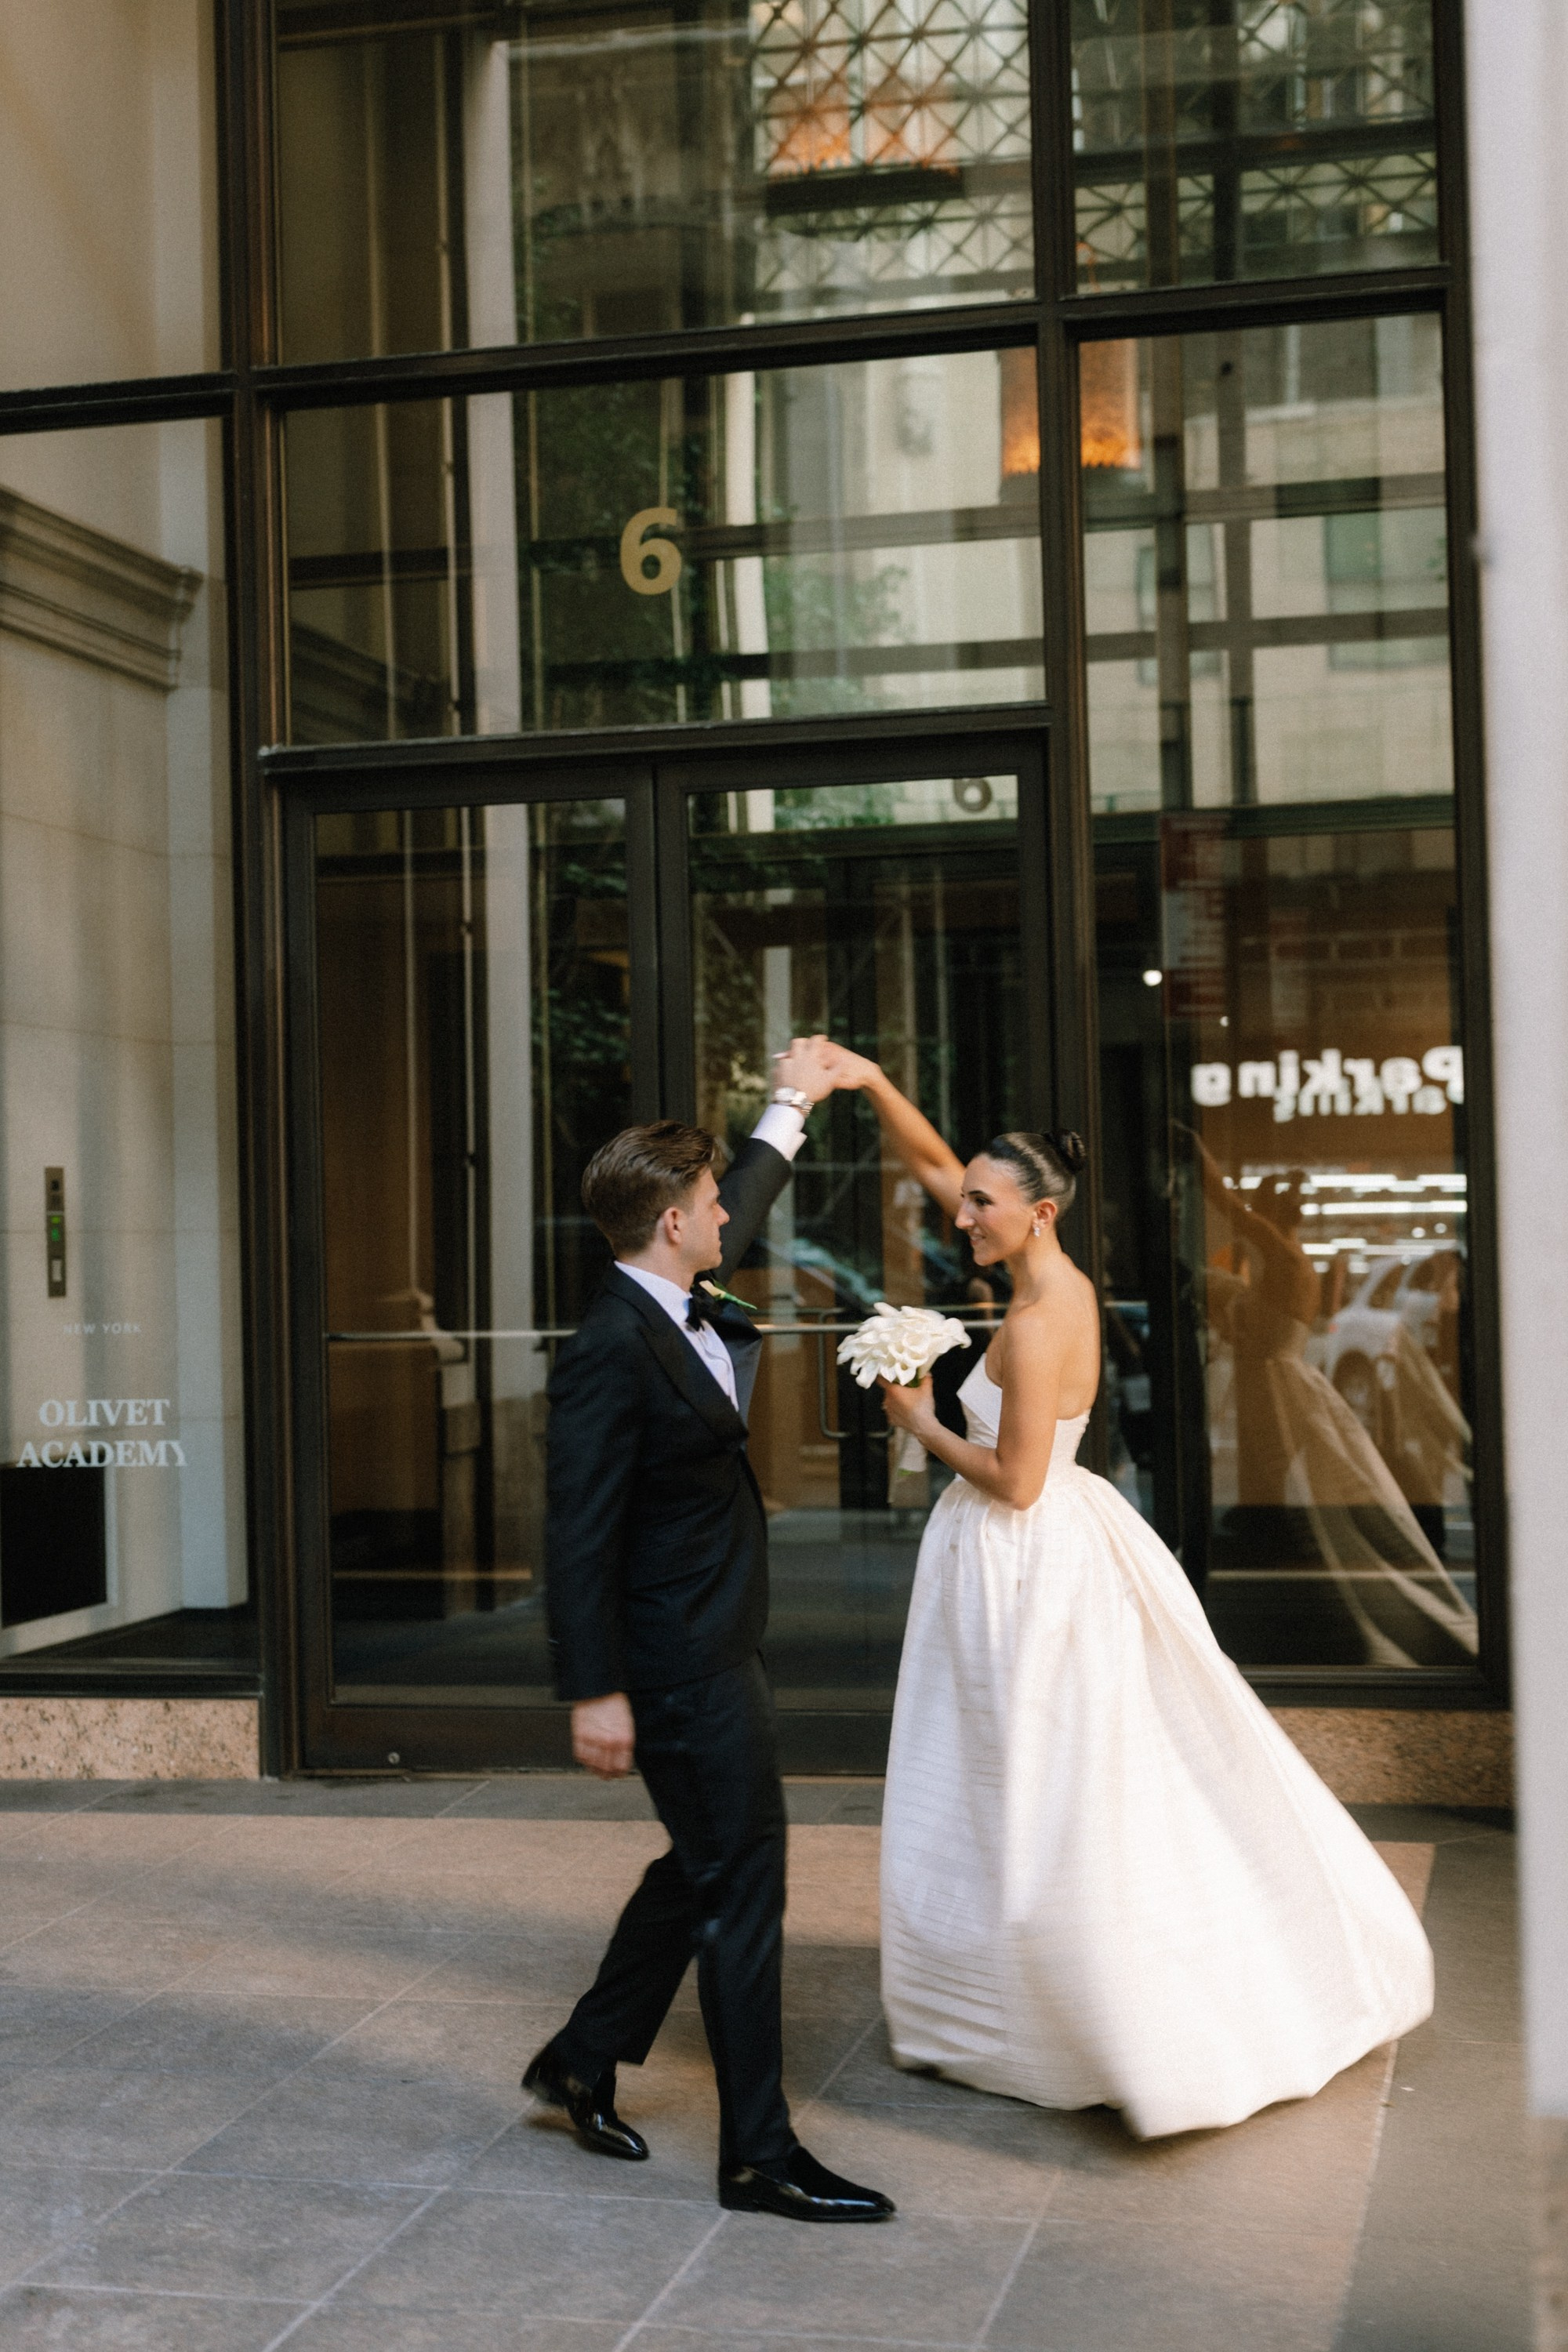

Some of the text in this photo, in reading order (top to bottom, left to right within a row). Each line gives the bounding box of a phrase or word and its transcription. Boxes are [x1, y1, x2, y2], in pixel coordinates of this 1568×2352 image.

[620, 507, 681, 594] 6
[63, 1323, 141, 1334] NEW YORK
[39, 1399, 170, 1427] OLIVET
[16, 1439, 188, 1468] ACADEMY
